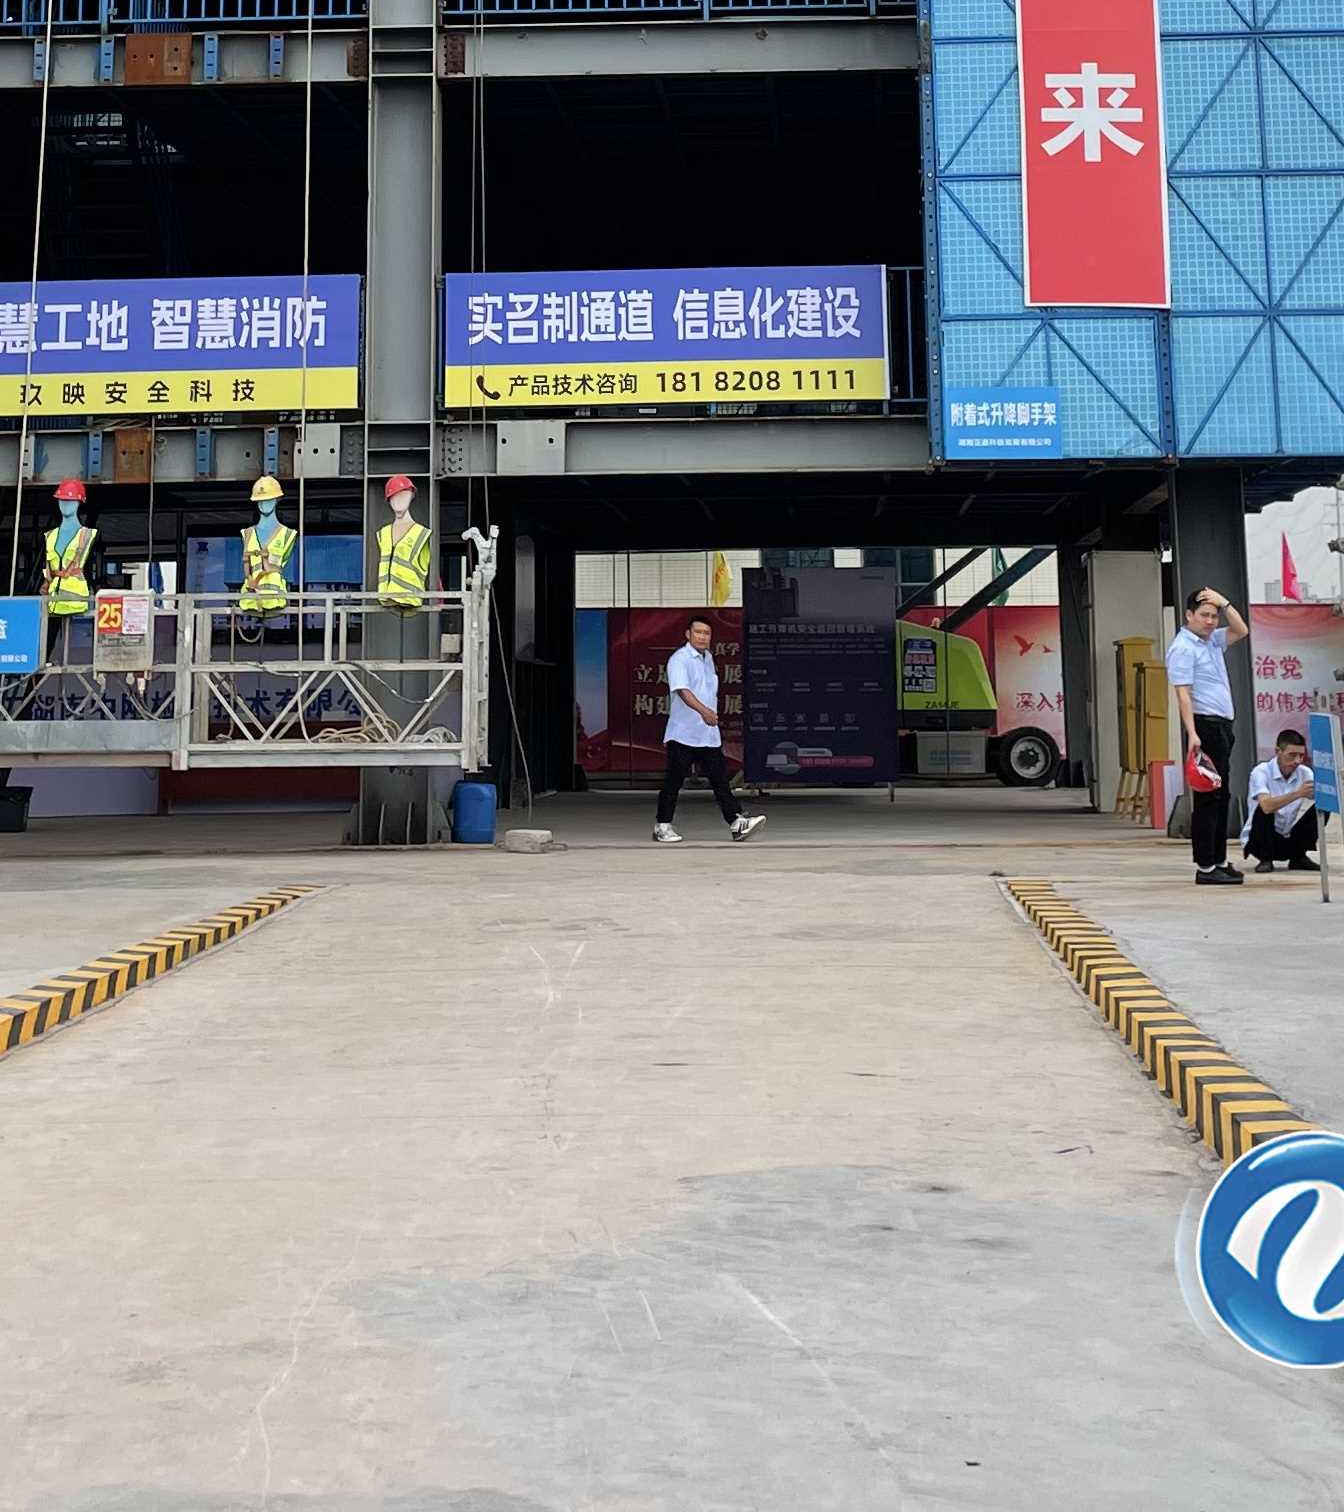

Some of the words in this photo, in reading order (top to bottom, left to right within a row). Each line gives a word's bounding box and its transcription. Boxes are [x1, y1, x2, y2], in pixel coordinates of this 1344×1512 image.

[151, 296, 328, 351] 智慧消防
[467, 289, 654, 347] 实名制通道
[672, 286, 862, 341] 信息化建设
[19, 378, 256, 407] 玖映安全科技
[508, 373, 639, 397] 产品技术咨询
[656, 372, 702, 393] 181
[714, 370, 781, 392] 8208
[792, 368, 856, 390] 1111
[950, 401, 1058, 427] 附着式升降脚手架
[98, 603, 123, 628] 25
[1255, 655, 1303, 680] 治党
